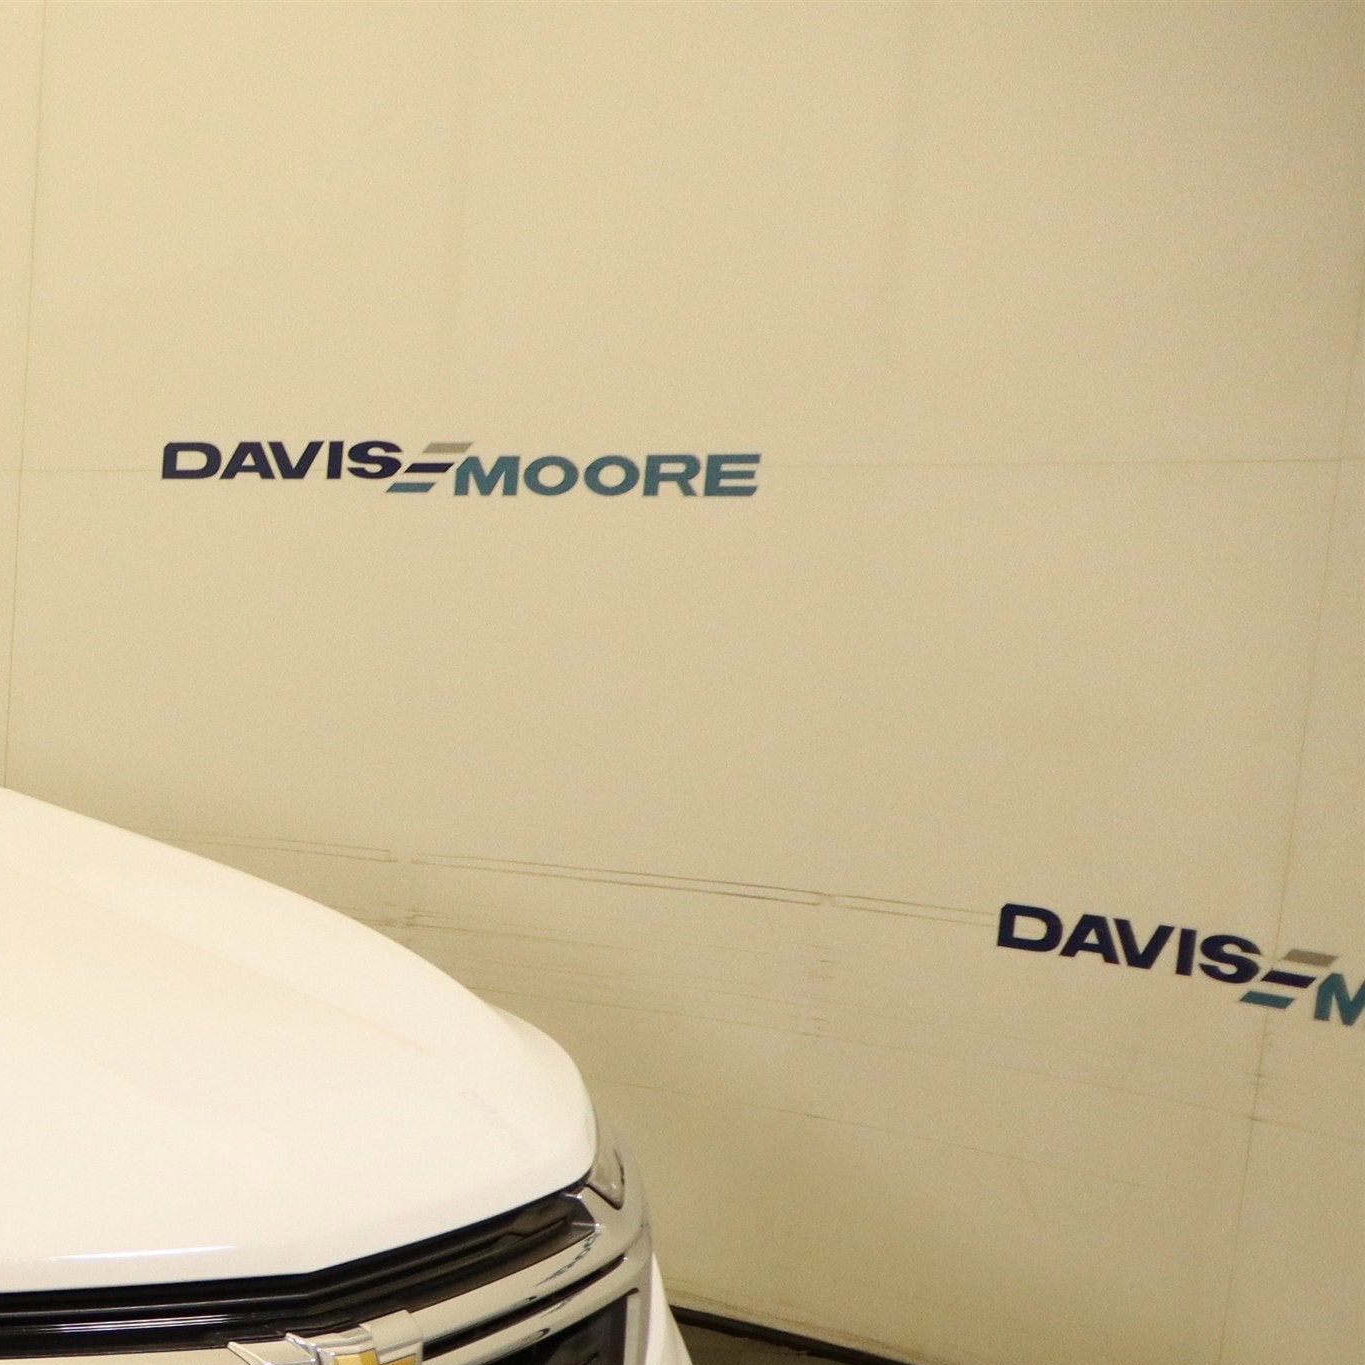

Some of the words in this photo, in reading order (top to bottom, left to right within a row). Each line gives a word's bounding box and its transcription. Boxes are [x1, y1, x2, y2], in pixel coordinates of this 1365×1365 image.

[161, 440, 404, 480] DAVIS
[453, 453, 762, 497] MOORE
[997, 903, 1262, 984] DAVIS
